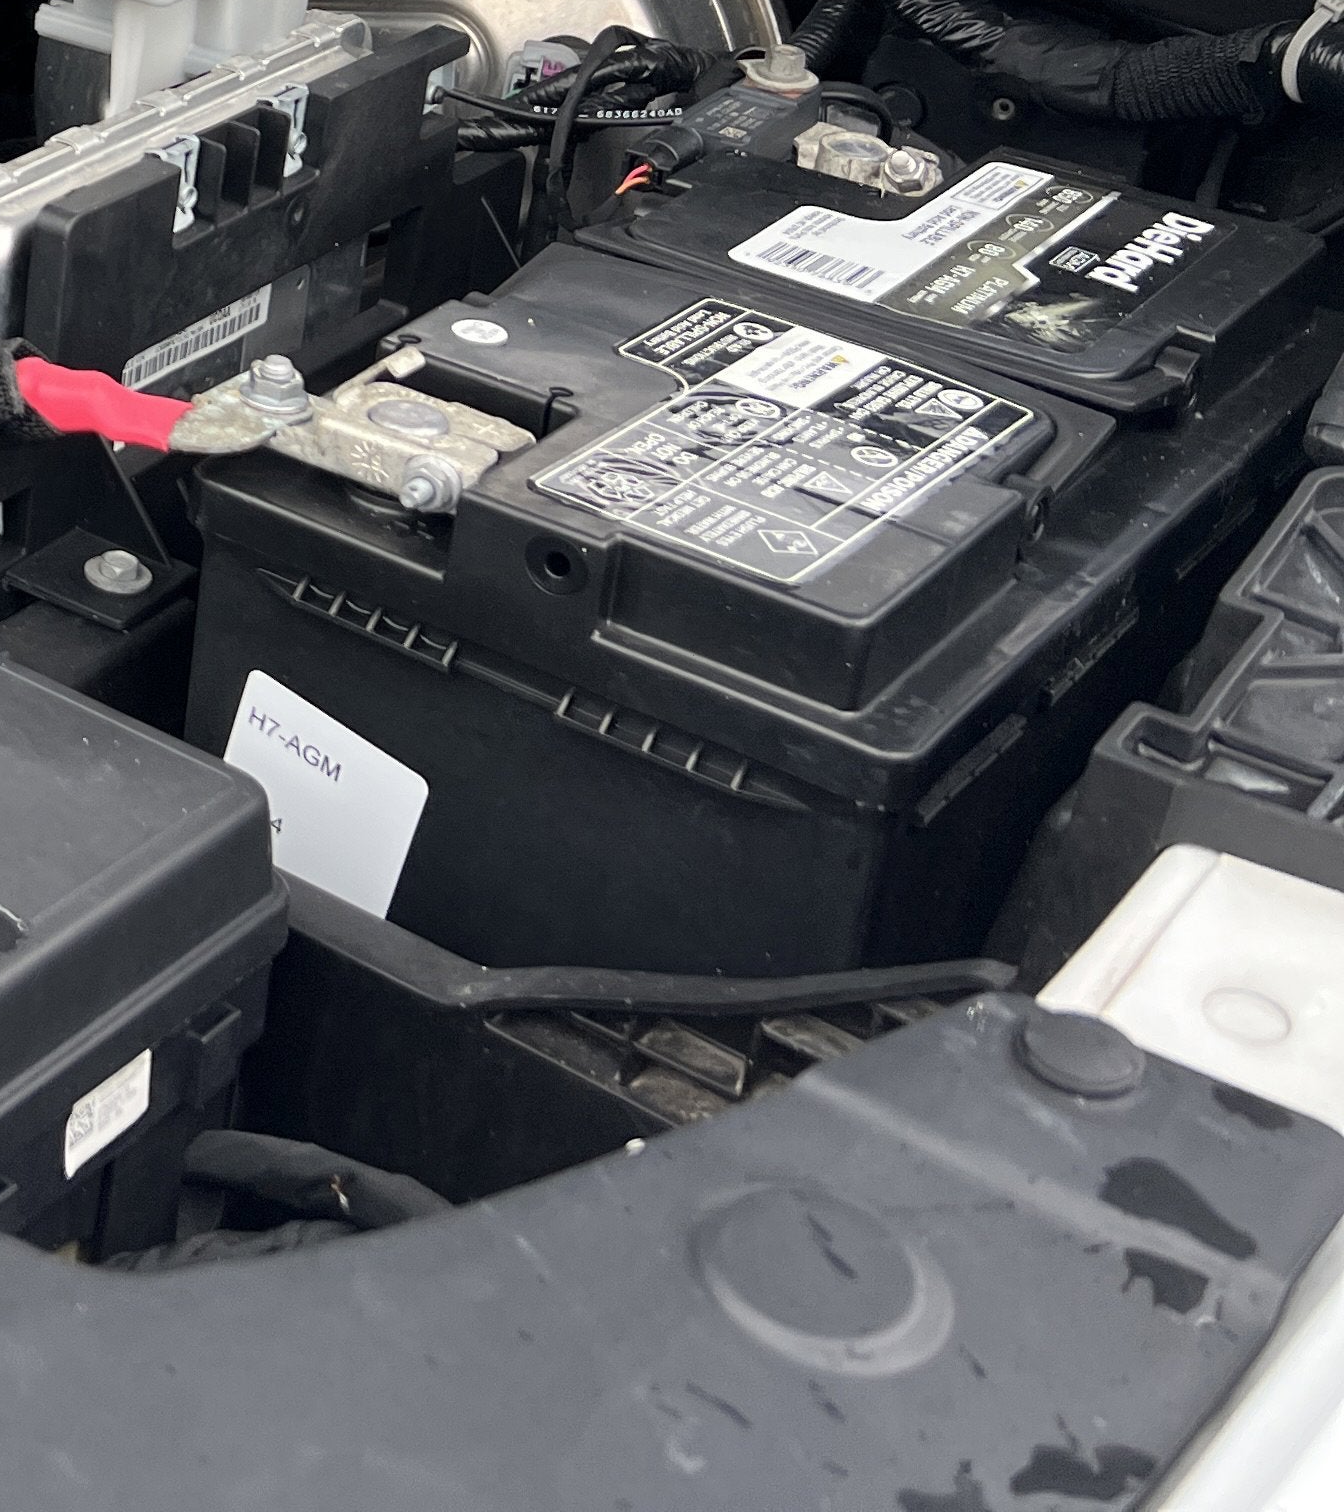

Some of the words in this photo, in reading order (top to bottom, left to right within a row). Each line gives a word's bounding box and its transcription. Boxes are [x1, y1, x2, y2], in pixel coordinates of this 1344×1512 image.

[1084, 212, 1215, 292] DieHard
[948, 276, 1010, 314] PLATINUM
[647, 441, 684, 460] NOT
[668, 450, 700, 466] DO
[857, 434, 979, 511] DANGER/POISON
[249, 706, 342, 782] H7-AGM
